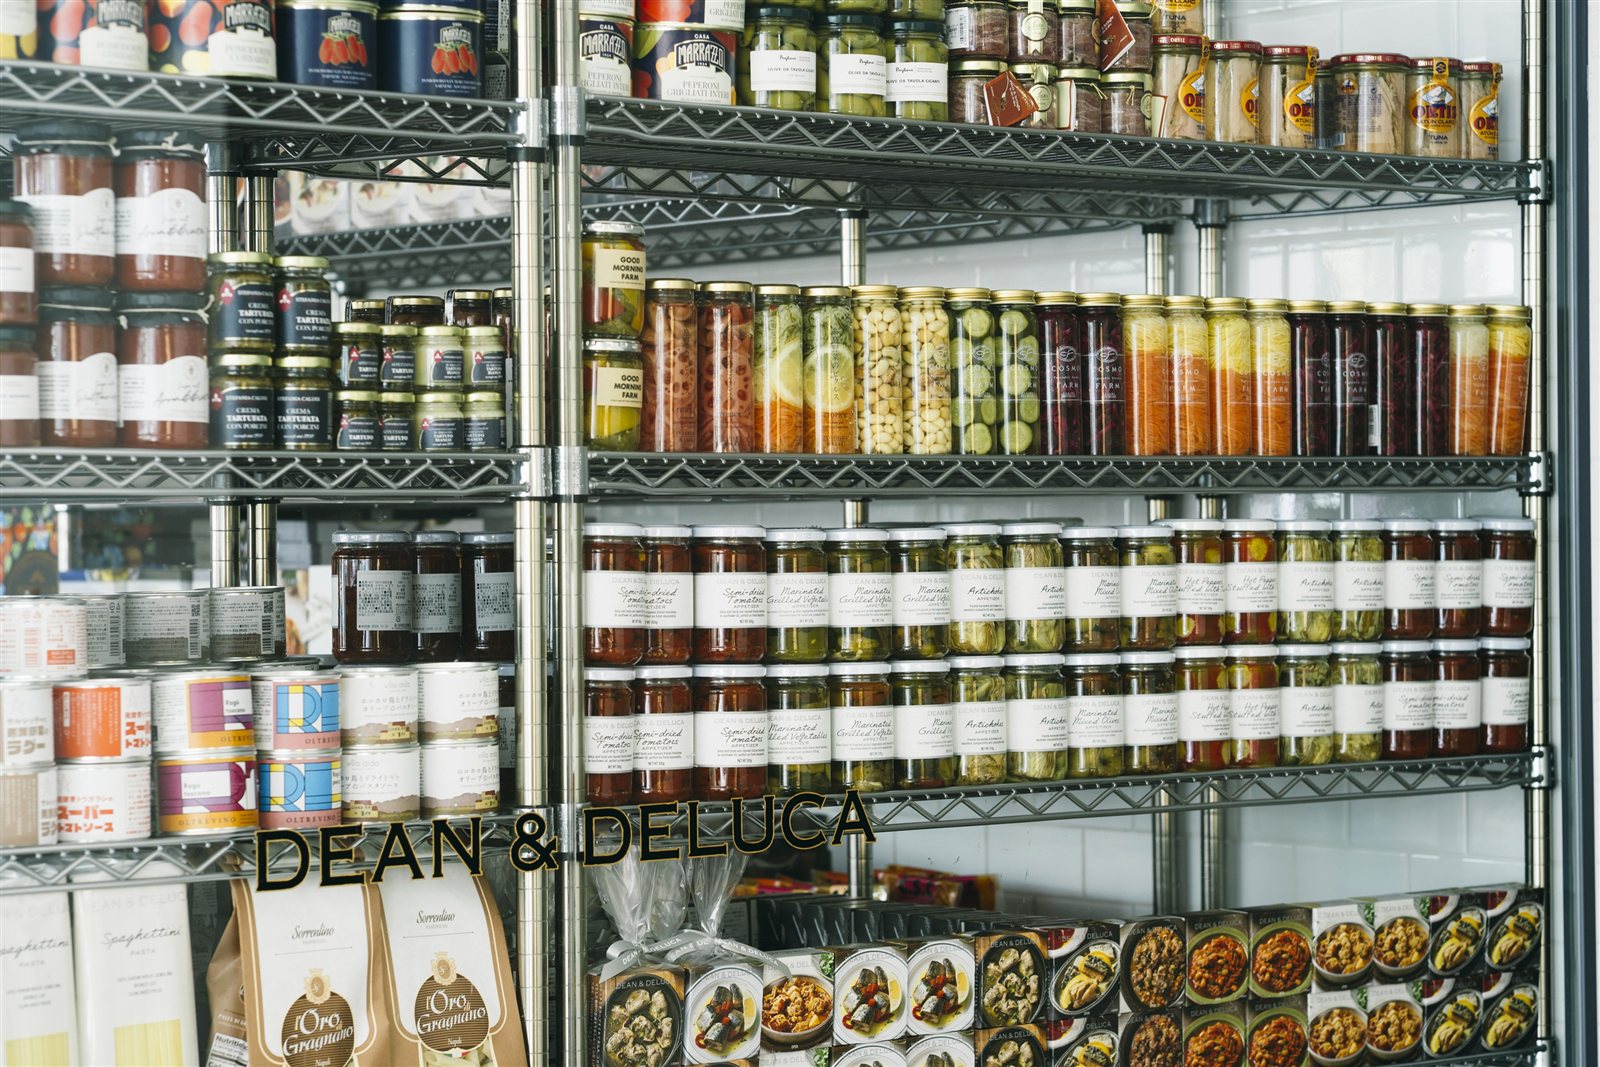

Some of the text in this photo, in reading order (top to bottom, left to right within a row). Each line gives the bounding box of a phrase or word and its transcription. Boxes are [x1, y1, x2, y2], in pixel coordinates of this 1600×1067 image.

[587, 71, 622, 82] PEPERONI
[683, 80, 720, 90] PEPERONI
[1412, 105, 1456, 119] ORTIZ
[620, 256, 641, 264] GOOD
[613, 264, 643, 273] MORNING
[621, 273, 640, 281] FARM
[622, 391, 638, 399] FARM
[1226, 584, 1259, 592] Stuffed
[767, 596, 802, 604] Grilled
[839, 595, 874, 604] Grilled
[902, 594, 936, 603] Grilled
[1078, 708, 1118, 717] Marinated
[1072, 717, 1099, 725] Mixed
[721, 727, 765, 735] Semi-dried
[768, 723, 818, 733] Marinated
[837, 728, 871, 737] Grilled
[634, 729, 682, 738] Semi-dried
[57, 806, 113, 820] スーパー
[178, 816, 237, 826] OLTREVINO
[286, 815, 337, 824] OLTREVINO
[57, 822, 114, 833] トマトソース
[256, 789, 876, 892] DEAN & DELUCA
[416, 907, 456, 924] Sorrentino
[1194, 919, 1243, 930] DEAN DELUCA
[1259, 917, 1276, 925] DEAN
[291, 922, 334, 940] Sorrentino
[1087, 930, 1113, 940] DELUCA
[101, 926, 182, 949] Spaghettini
[649, 936, 683, 953] DELUCA
[990, 939, 1009, 948] DEAN
[0, 939, 69, 959] paghettini
[621, 951, 638, 965] DEAN
[617, 981, 638, 990] DEAN
[426, 989, 471, 1014] l'Oro di
[294, 1008, 341, 1034] l'Oro
[416, 1007, 487, 1035] Gragnano
[1086, 1020, 1112, 1030] DELUCA
[283, 1026, 354, 1056] Gragnano
[990, 1031, 1007, 1041] DEAN
[447, 1038, 462, 1047] Napoli
